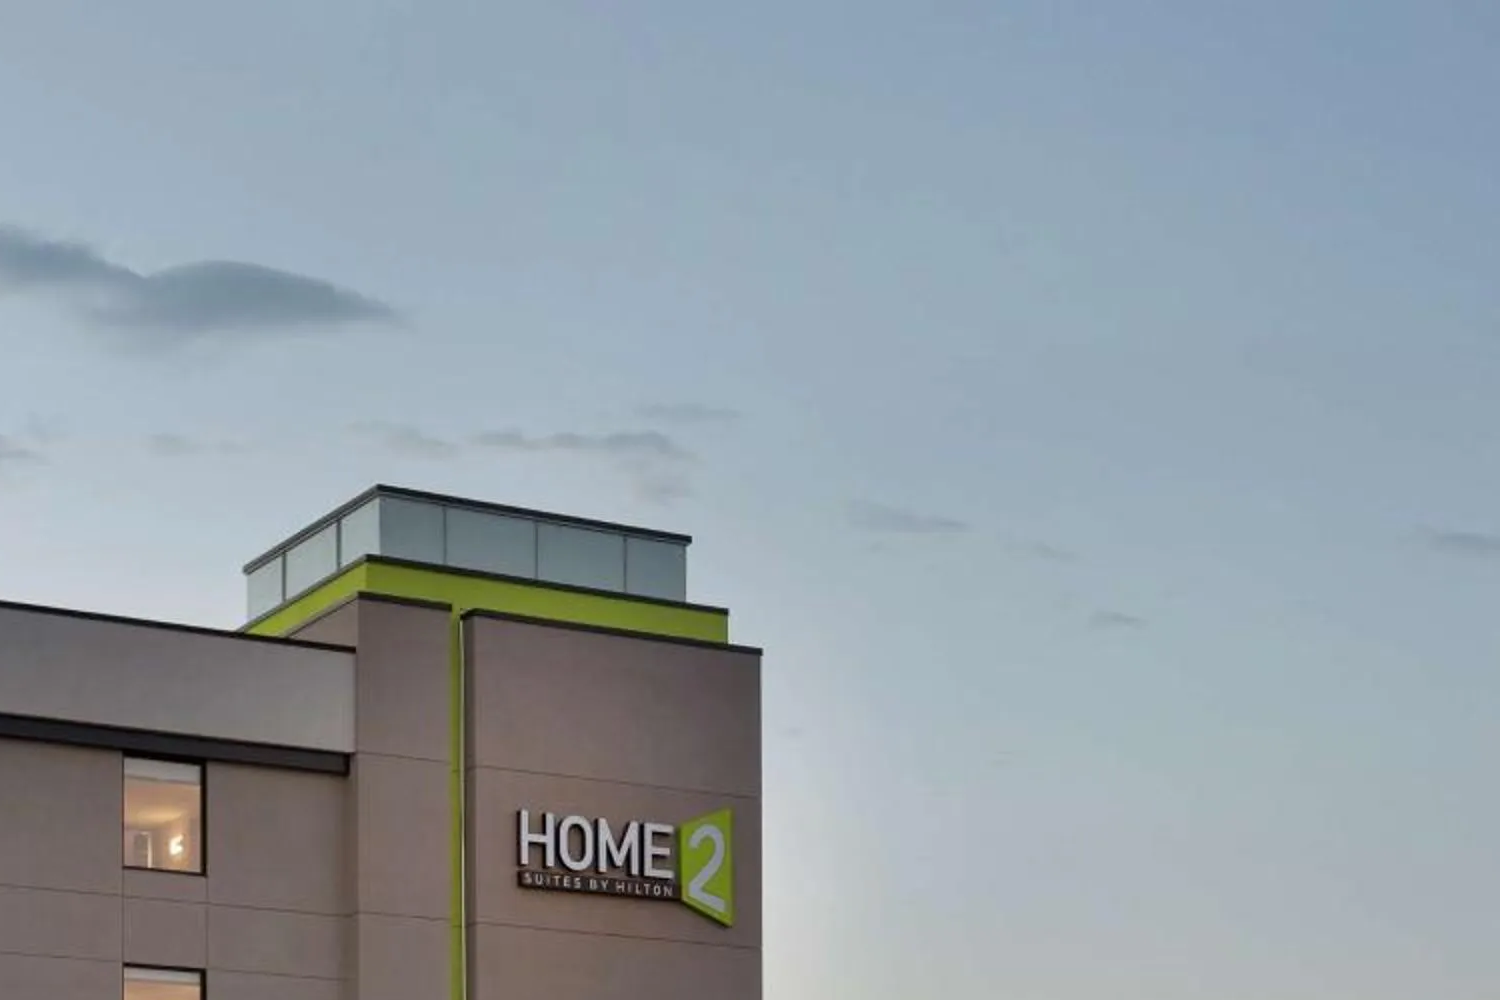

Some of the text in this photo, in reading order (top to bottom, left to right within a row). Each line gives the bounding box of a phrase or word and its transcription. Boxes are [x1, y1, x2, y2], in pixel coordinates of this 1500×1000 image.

[519, 809, 725, 912] HOME 2
[524, 871, 674, 897] SUITES BY HILTON
